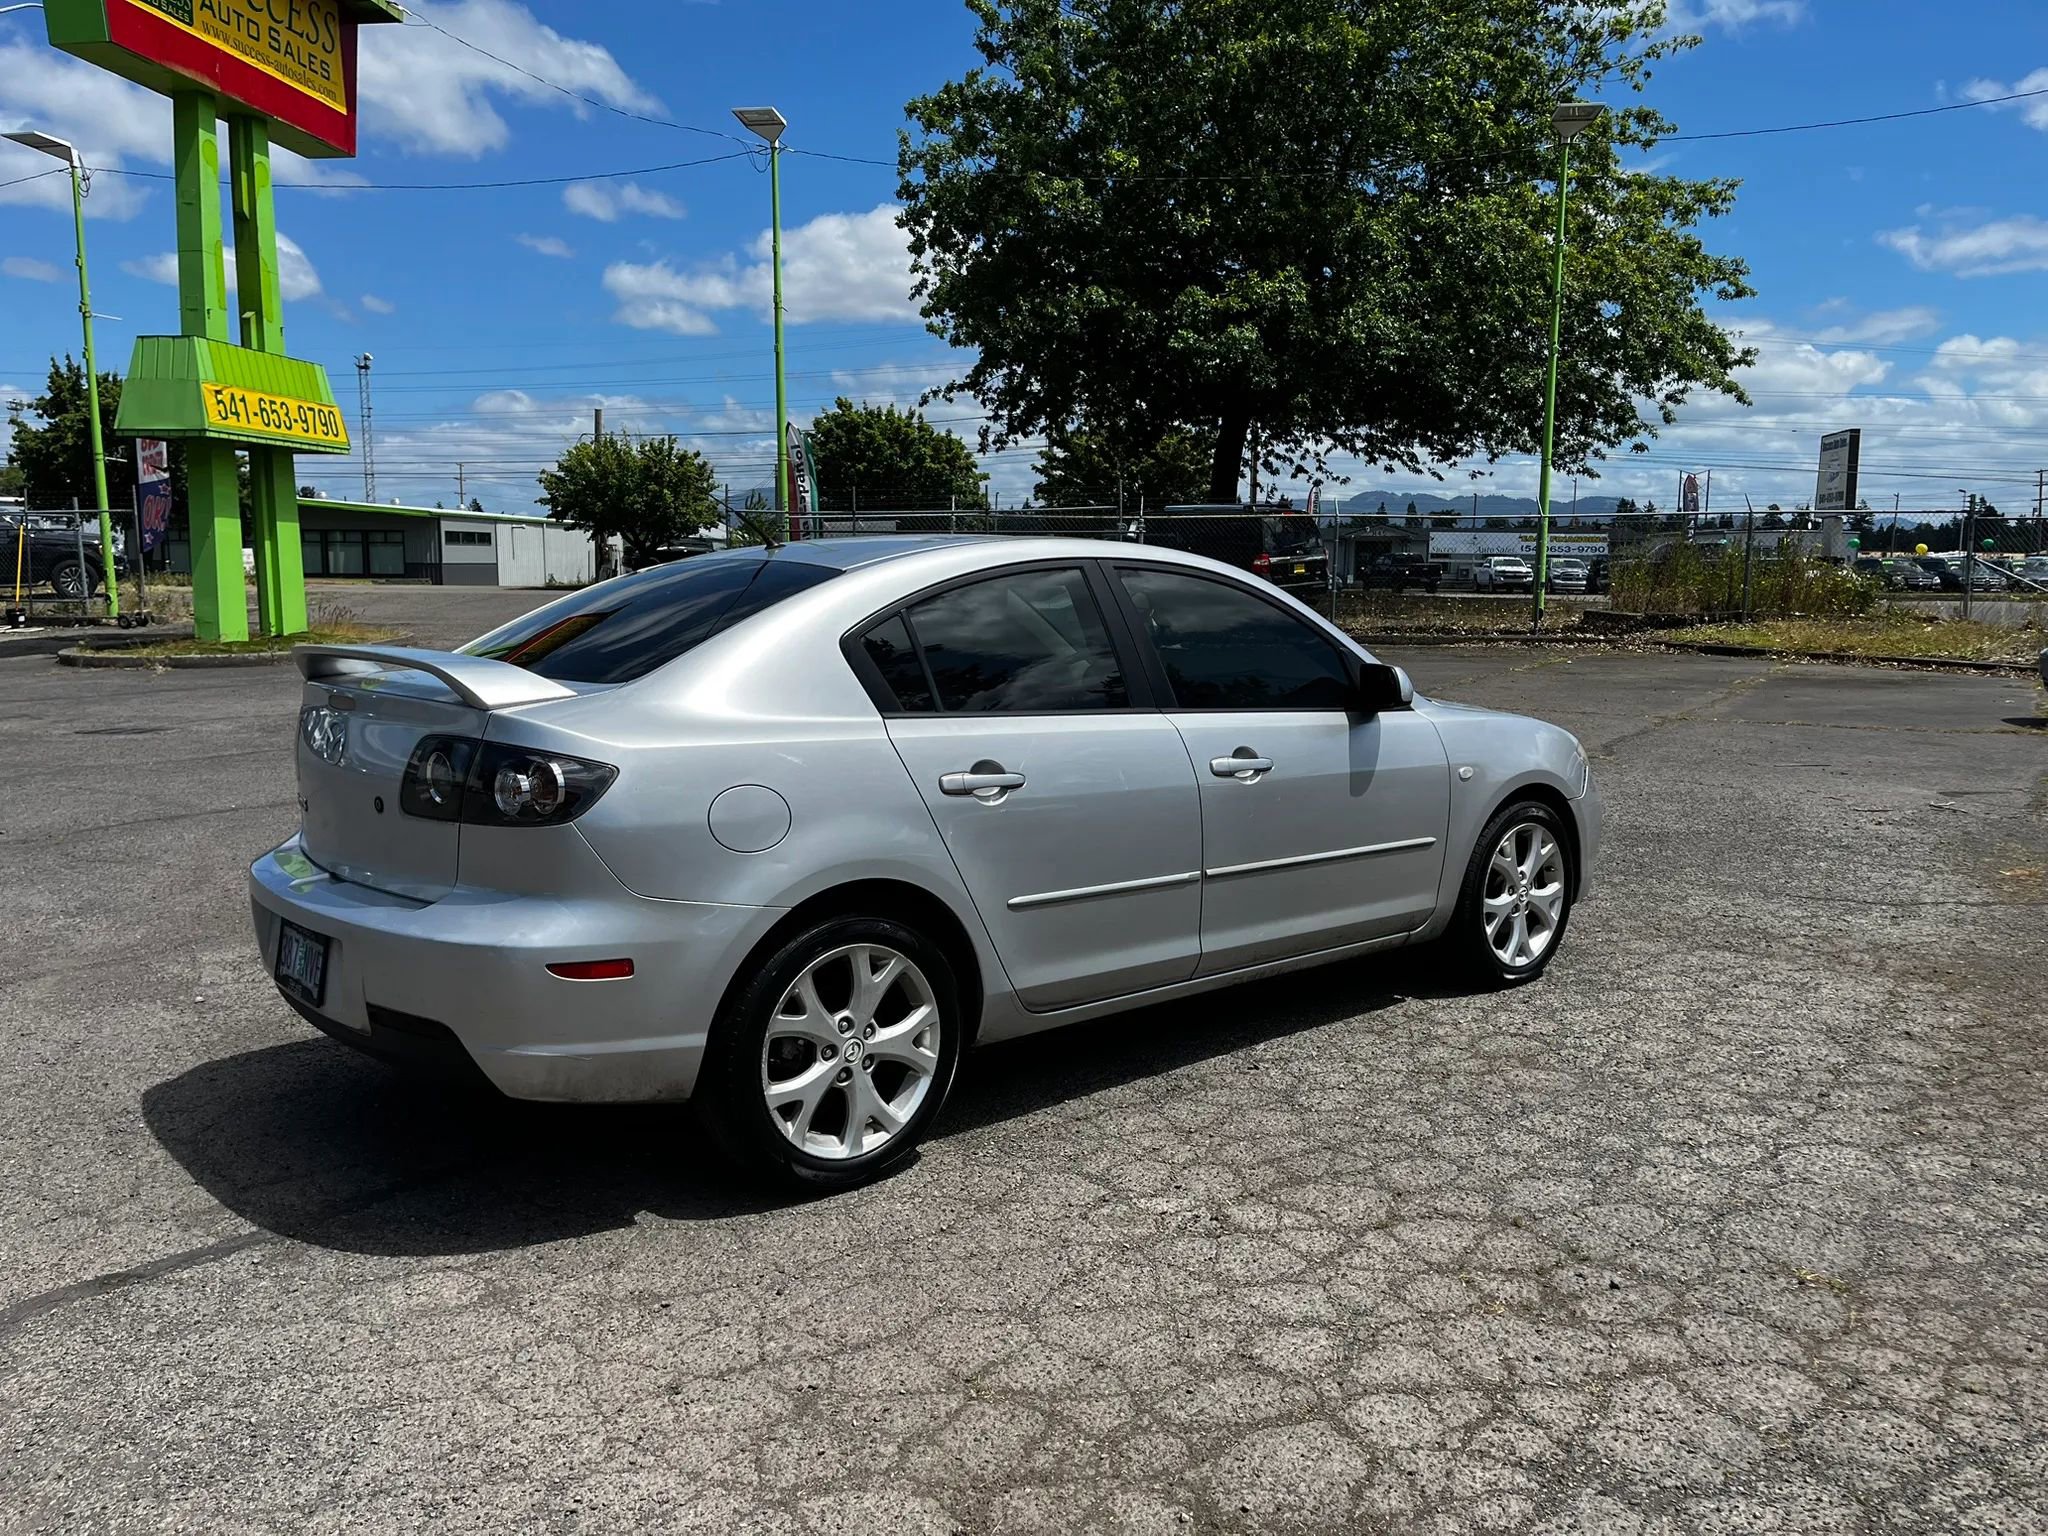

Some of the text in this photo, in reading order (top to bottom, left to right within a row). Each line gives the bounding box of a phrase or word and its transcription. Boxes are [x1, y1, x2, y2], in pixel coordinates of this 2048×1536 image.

[200, 0, 331, 81] AUTO SALES
[202, 20, 337, 101] www.success-autosales.com
[214, 389, 340, 439] 541-653-9790
